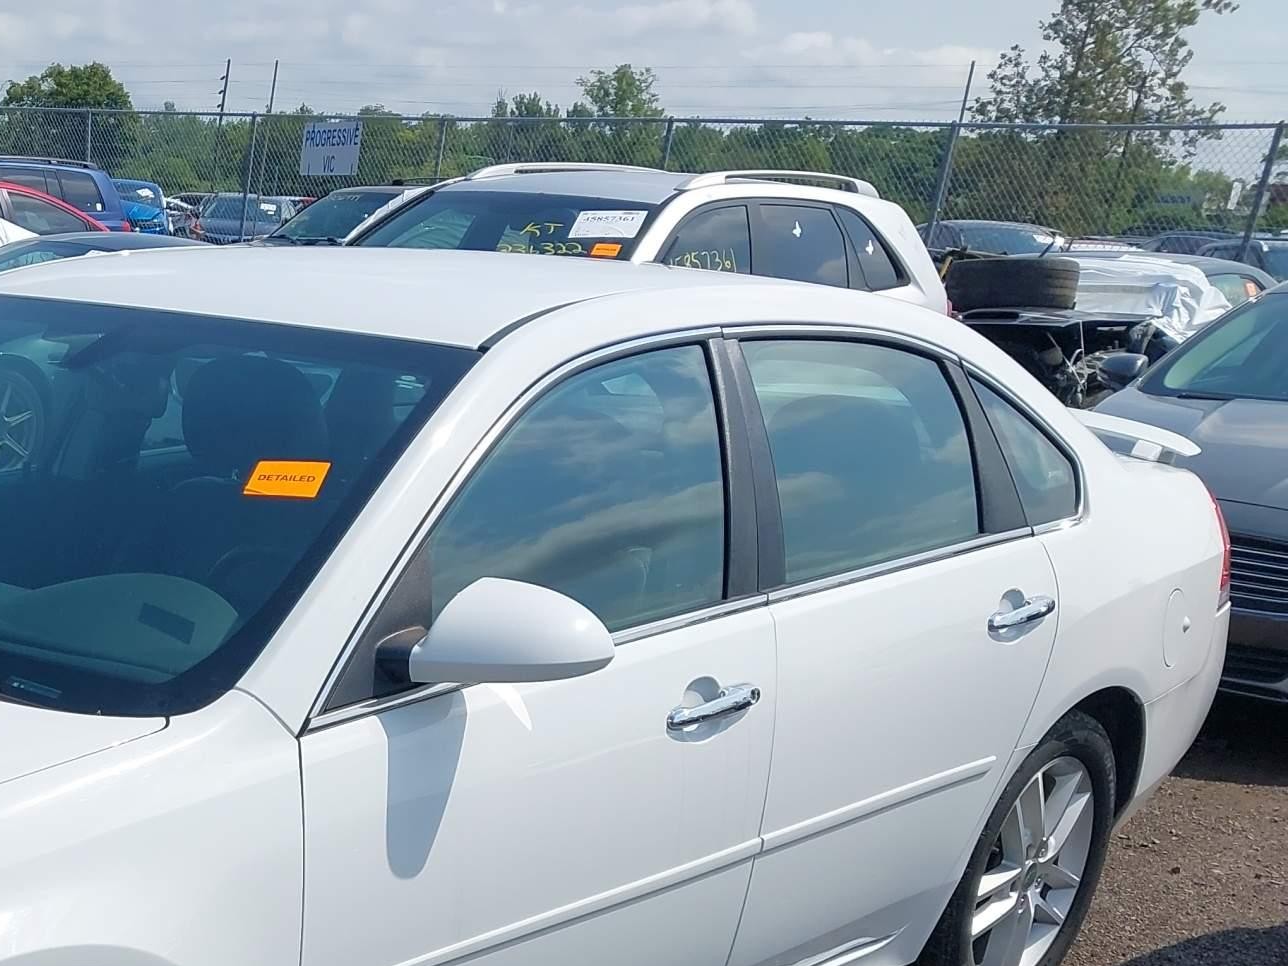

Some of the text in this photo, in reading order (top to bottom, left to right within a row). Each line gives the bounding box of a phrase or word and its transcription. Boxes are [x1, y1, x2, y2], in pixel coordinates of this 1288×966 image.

[305, 127, 360, 148] PROGRESSIVE
[322, 155, 336, 173] VIC
[670, 248, 736, 272] 5857361
[257, 474, 316, 483] DETAILED
